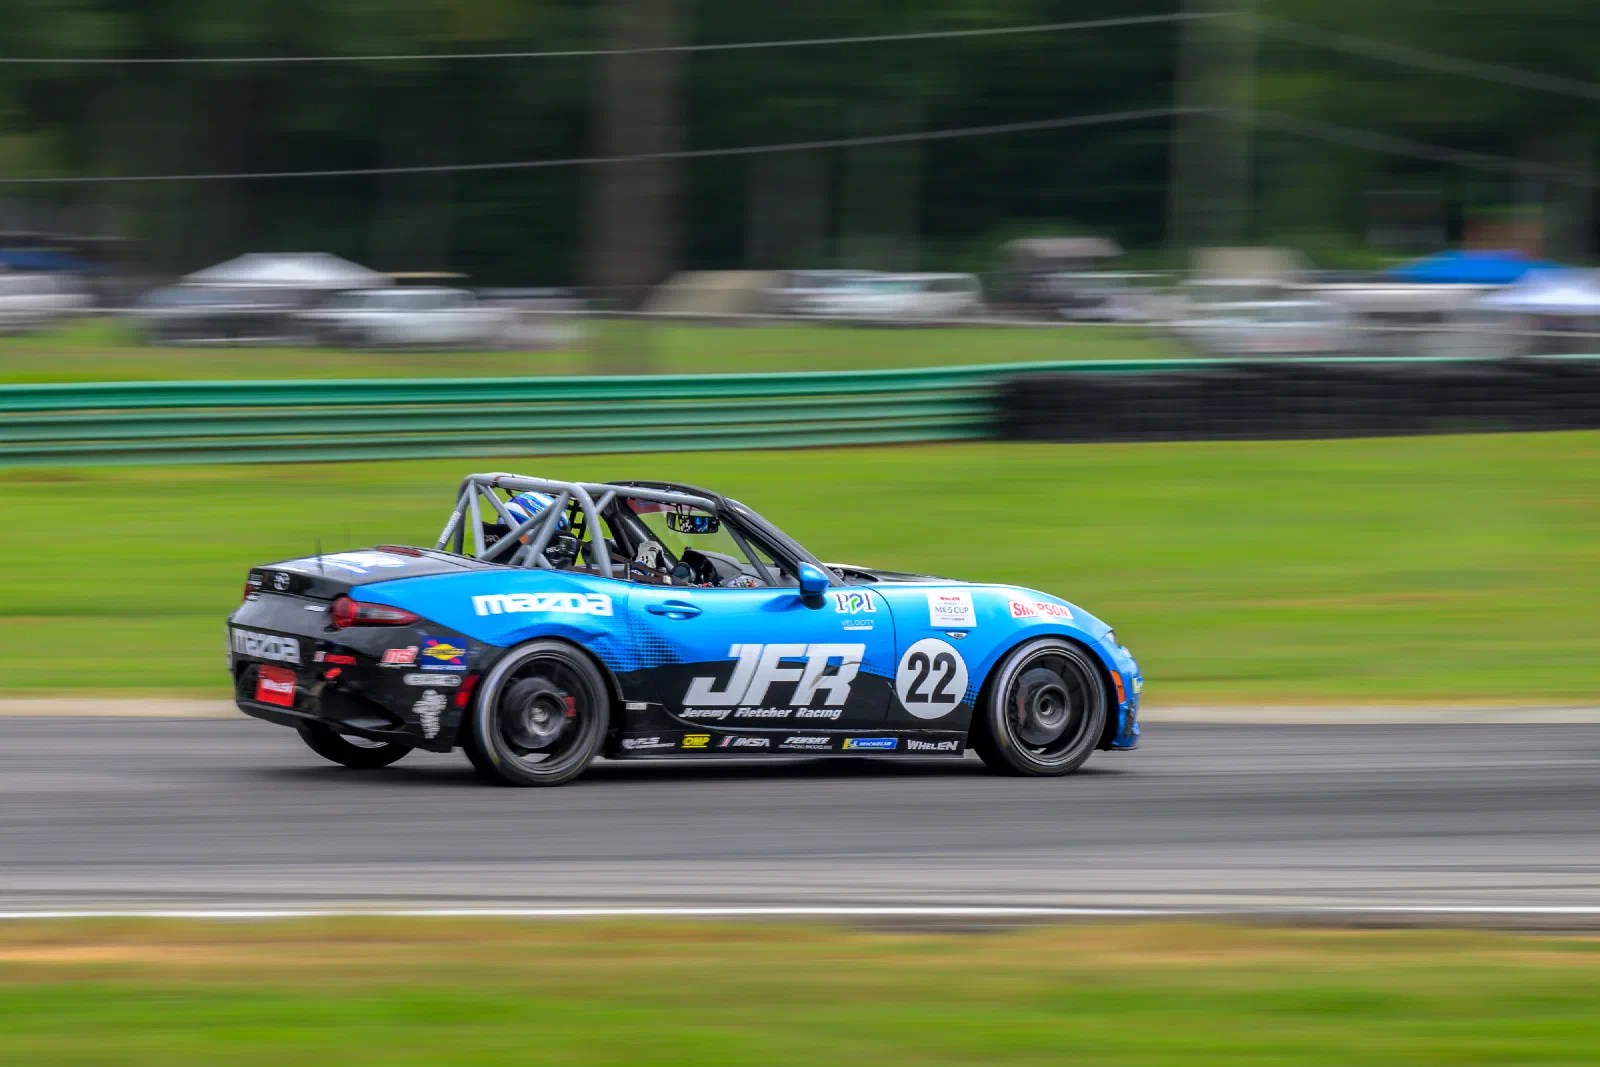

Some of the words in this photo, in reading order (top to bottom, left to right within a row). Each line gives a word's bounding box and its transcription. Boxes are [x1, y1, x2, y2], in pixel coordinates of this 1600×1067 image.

[934, 606, 953, 614] MX-5
[953, 606, 969, 614] CUP
[681, 643, 866, 706] JFR
[905, 651, 957, 704] 22
[678, 707, 732, 721] Jeremy
[734, 707, 792, 719] Fletcher
[796, 707, 842, 720] Racing
[682, 736, 711, 747] OMP
[732, 737, 771, 747] IMSA
[783, 736, 831, 744] PENSKE
[907, 739, 959, 751] WHELEN
